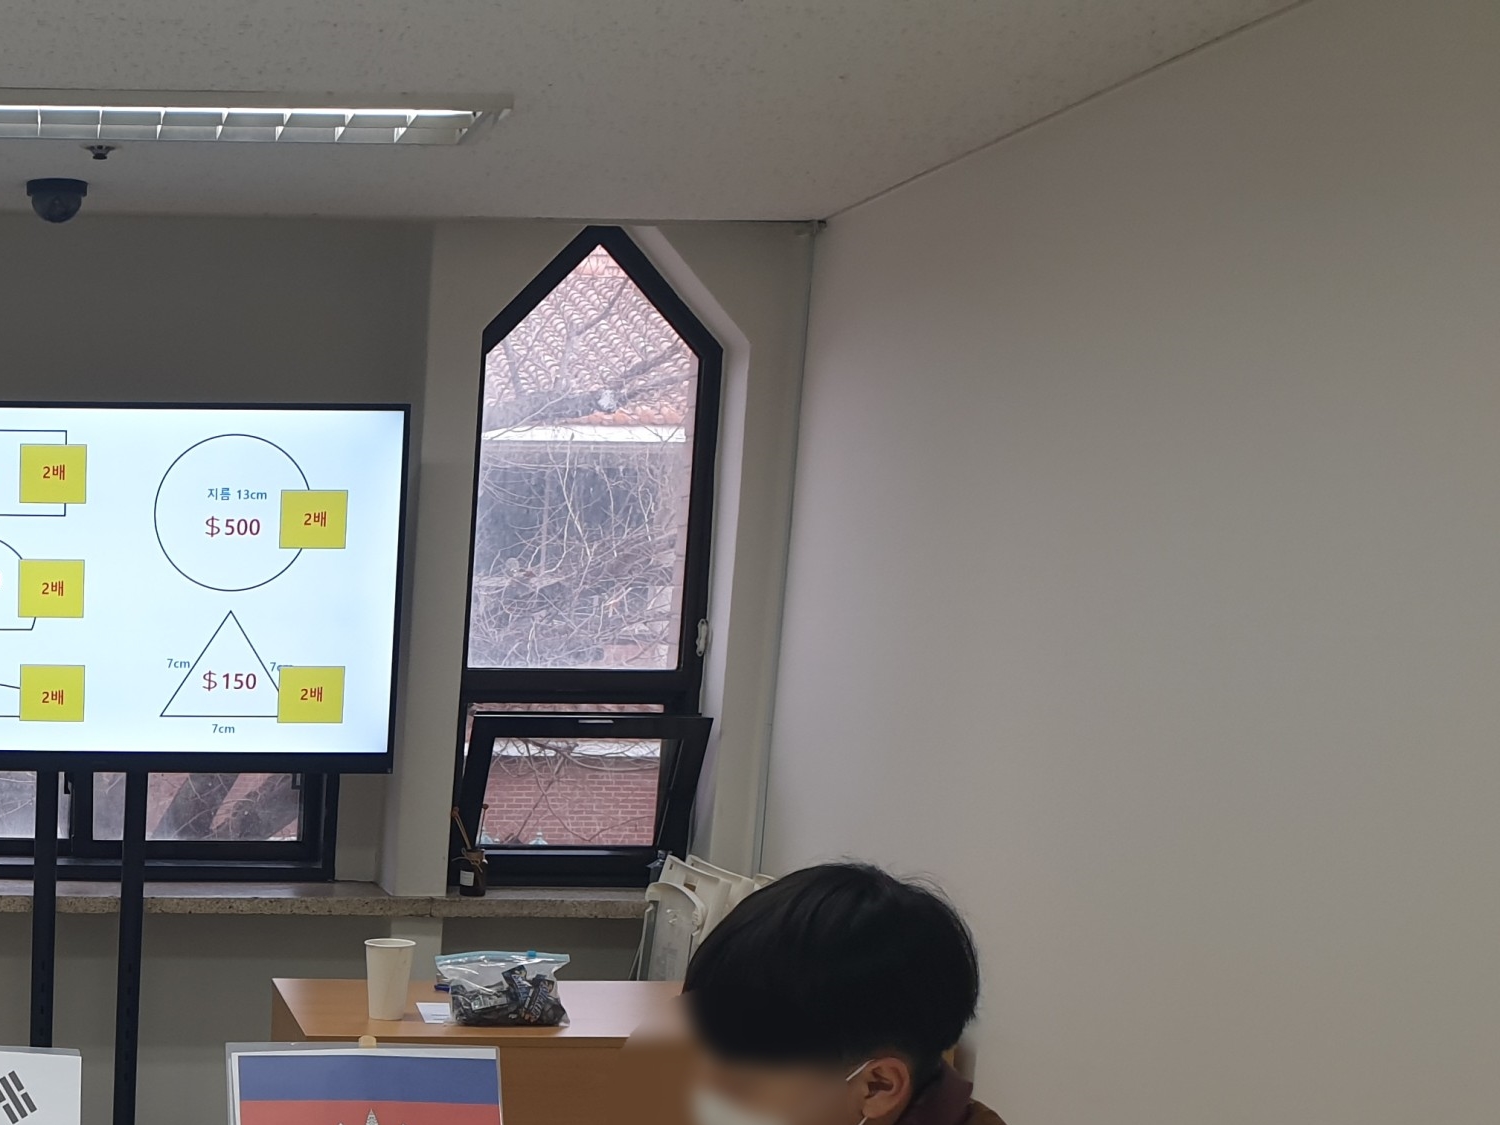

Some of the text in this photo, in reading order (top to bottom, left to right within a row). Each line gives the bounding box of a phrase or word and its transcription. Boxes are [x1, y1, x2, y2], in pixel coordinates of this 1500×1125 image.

[42, 464, 65, 480] 2배
[207, 487, 267, 501] 지름 13cm
[205, 516, 260, 537] $500
[303, 511, 327, 527] 2배
[41, 580, 64, 596] 2배
[166, 658, 190, 669] 7cm
[202, 670, 257, 692] $150
[41, 689, 64, 706] 2배
[300, 686, 323, 702] 2배
[211, 723, 235, 734] 7cm
